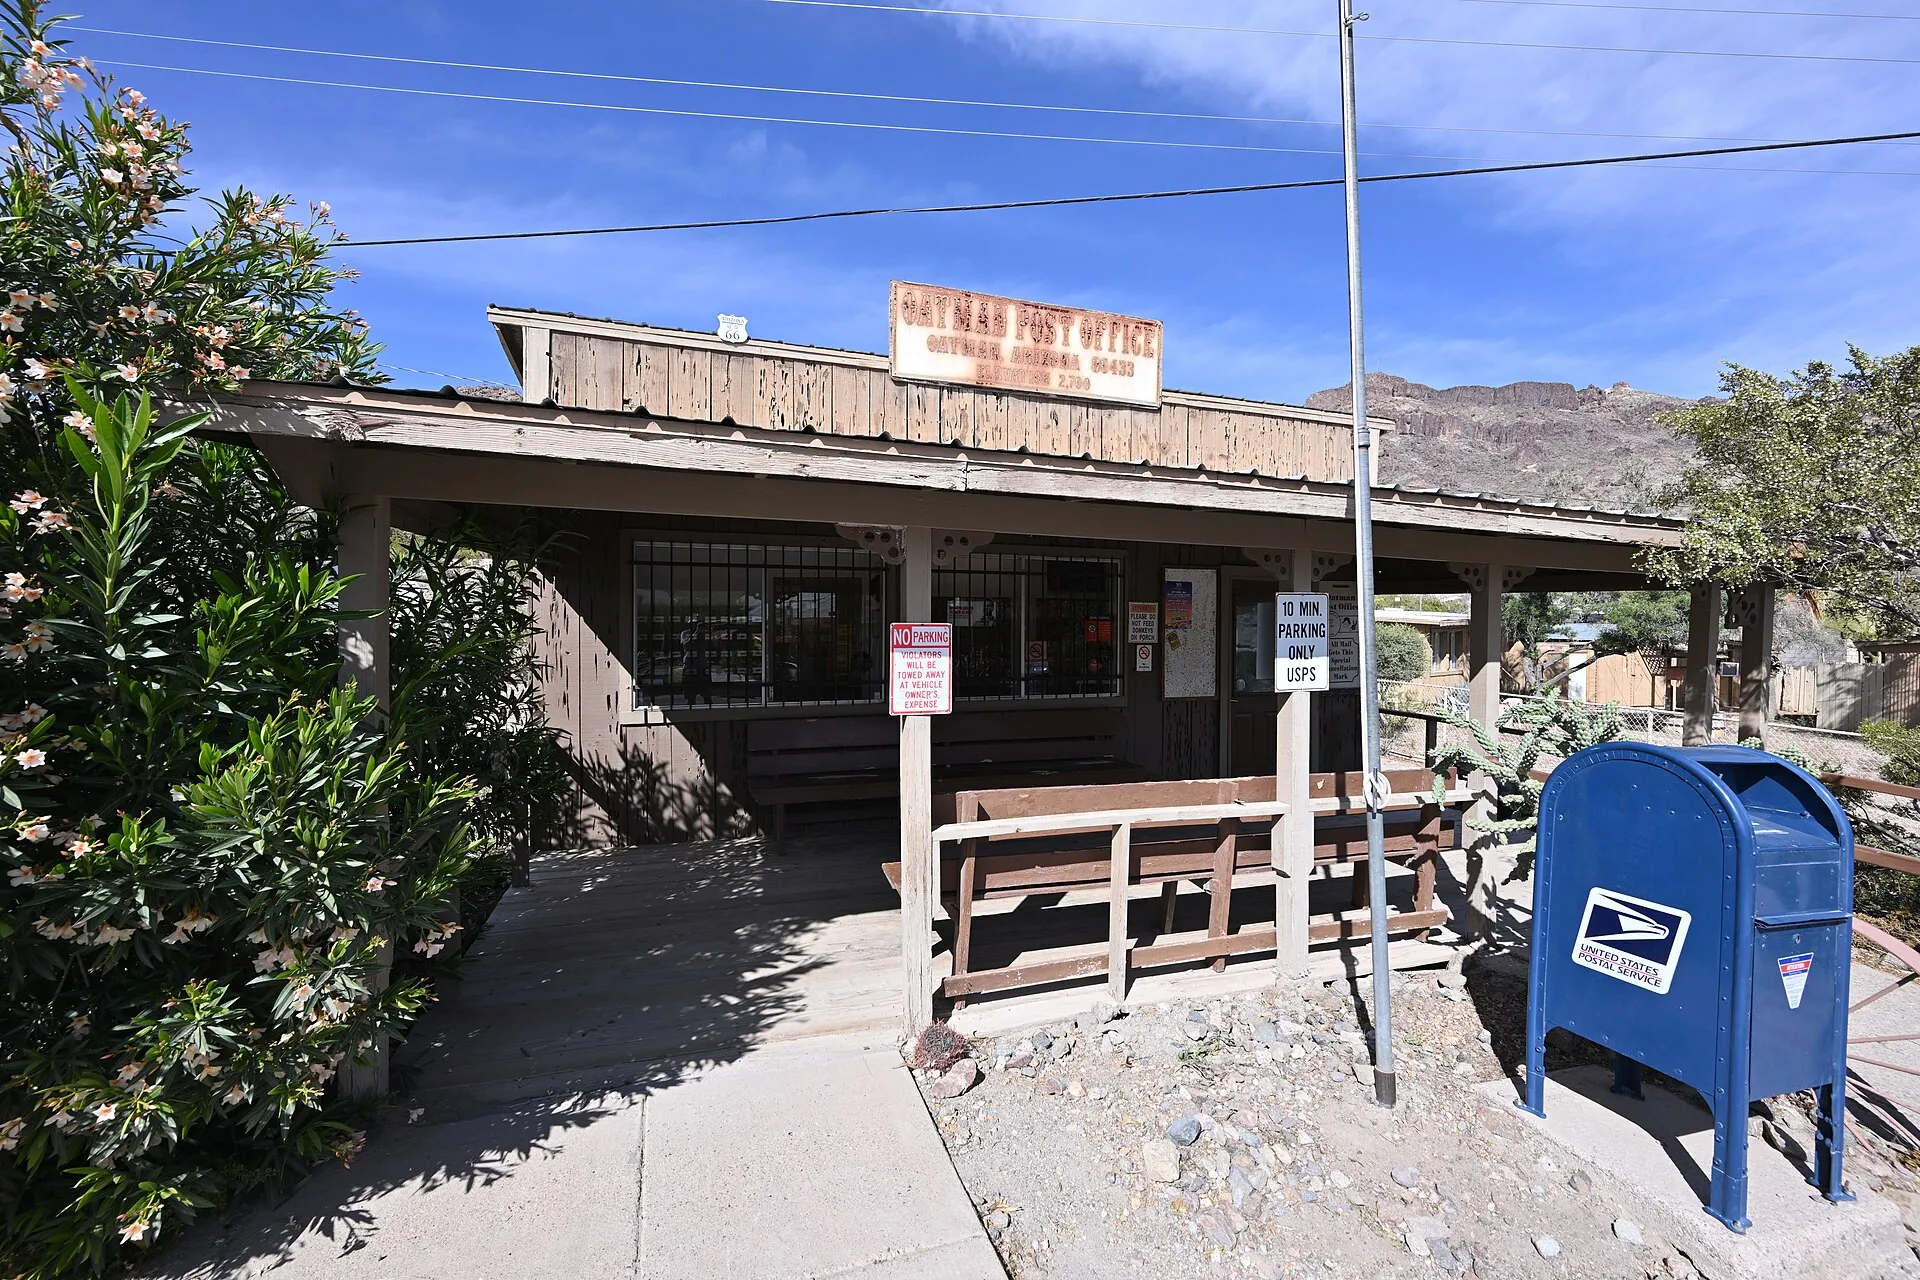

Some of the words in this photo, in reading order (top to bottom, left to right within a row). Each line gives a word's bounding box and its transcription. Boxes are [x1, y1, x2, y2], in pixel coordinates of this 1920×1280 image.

[902, 290, 1007, 338] OATMAN
[1015, 305, 1075, 346] POST
[1080, 317, 1156, 358] OFFICE
[725, 330, 740, 340] 66
[1011, 345, 1080, 370] ARIZONA
[1283, 601, 1294, 616] 10
[1299, 601, 1322, 617] MIN.
[893, 628, 911, 646] NO
[913, 631, 949, 643] PARKING
[1278, 623, 1326, 639] PARKING
[901, 650, 942, 660] VIOLATORS
[1288, 644, 1316, 661] ONLY
[906, 660, 924, 669] WILL
[927, 660, 937, 669] BE
[1330, 656, 1351, 666] Special
[897, 671, 923, 680] TOWED
[925, 670, 946, 679] AWAY
[1287, 666, 1316, 683] USPS
[1334, 672, 1348, 680] Mark
[899, 681, 909, 690] AT
[912, 680, 943, 689] VEHICLE
[904, 690, 938, 700] OWNER'S
[904, 700, 938, 709] EXPENSE
[1580, 943, 1619, 962] UNITED
[1619, 957, 1660, 976] STATES
[1578, 952, 1615, 972] POSTAL
[1617, 966, 1663, 988] SERVICE
